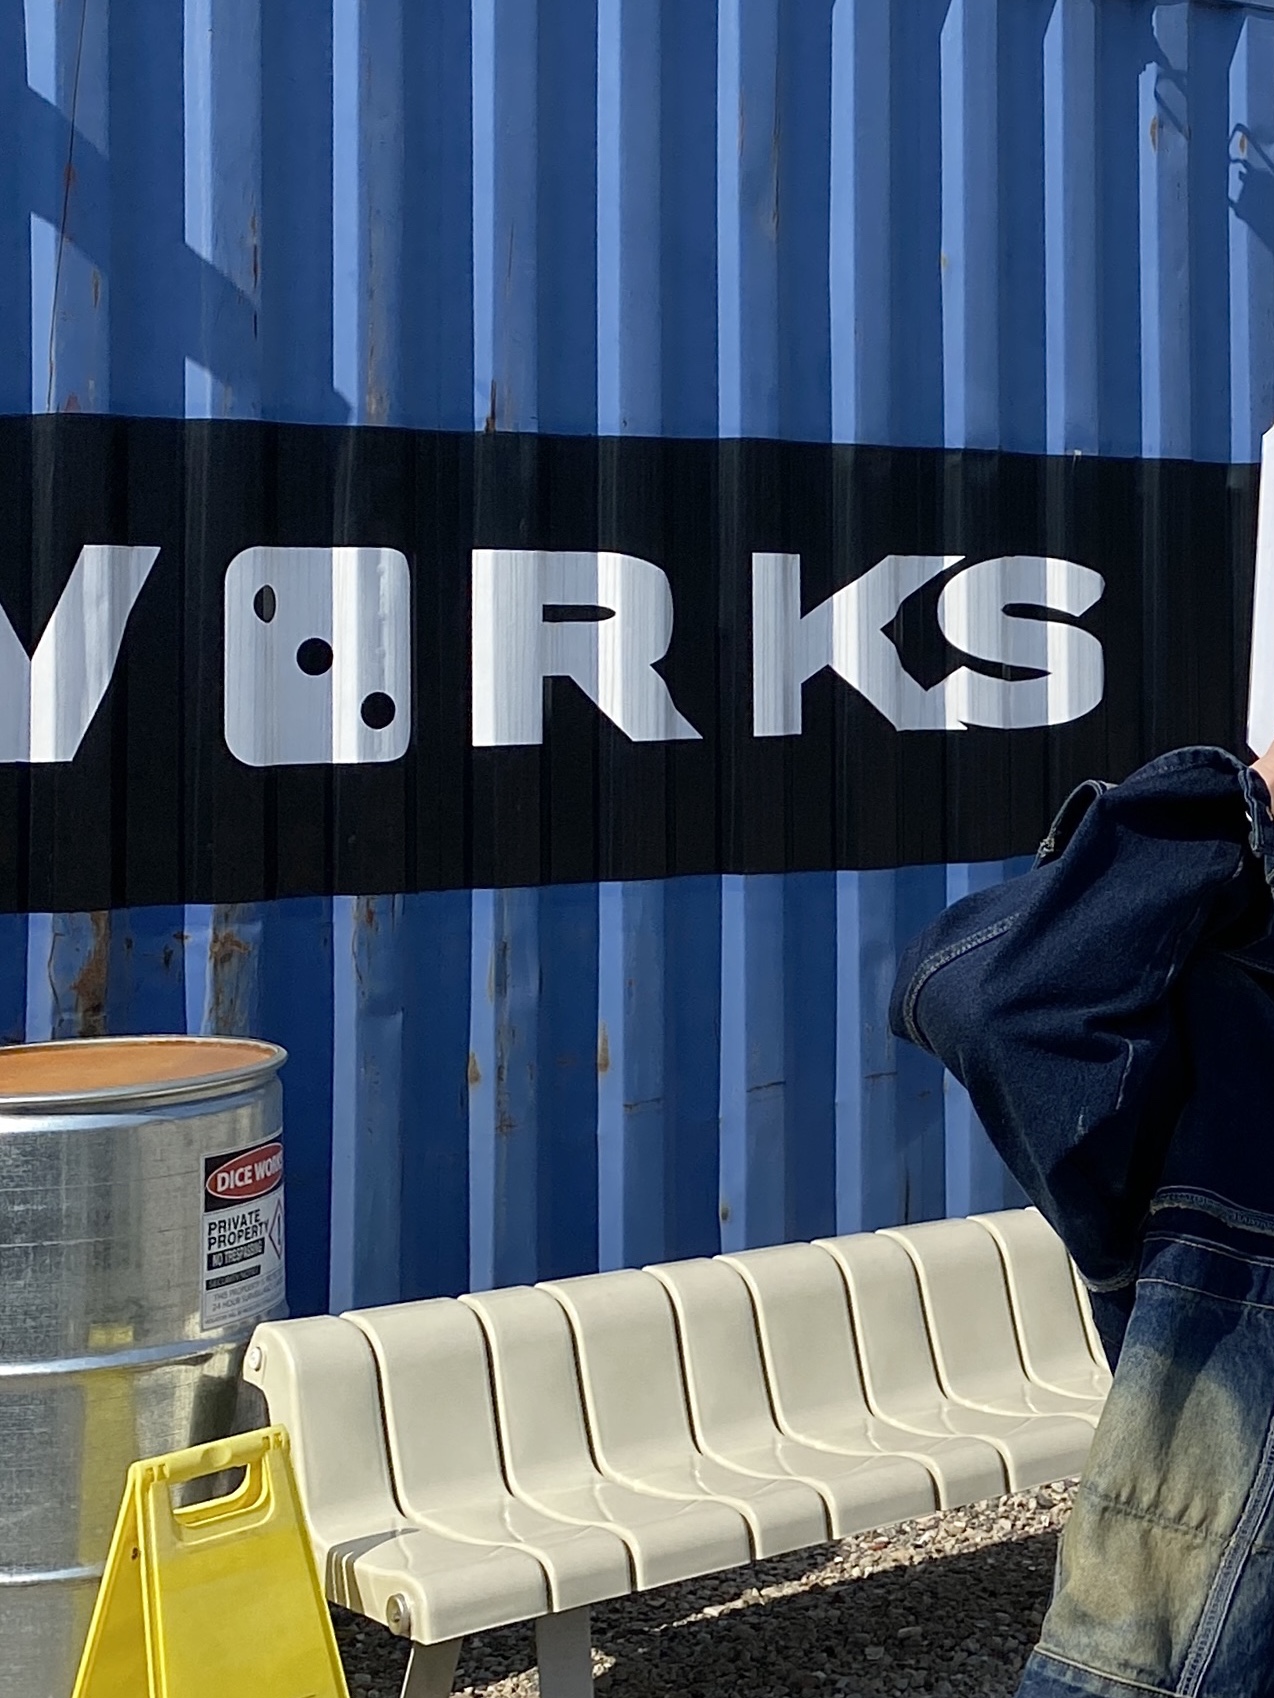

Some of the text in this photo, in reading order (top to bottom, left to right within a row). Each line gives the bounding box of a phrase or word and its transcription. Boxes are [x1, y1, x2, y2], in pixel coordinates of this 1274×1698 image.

[216, 1164, 253, 1193] DICE
[208, 1209, 261, 1236] PRIVATE
[208, 1218, 269, 1251] PROPERTY
